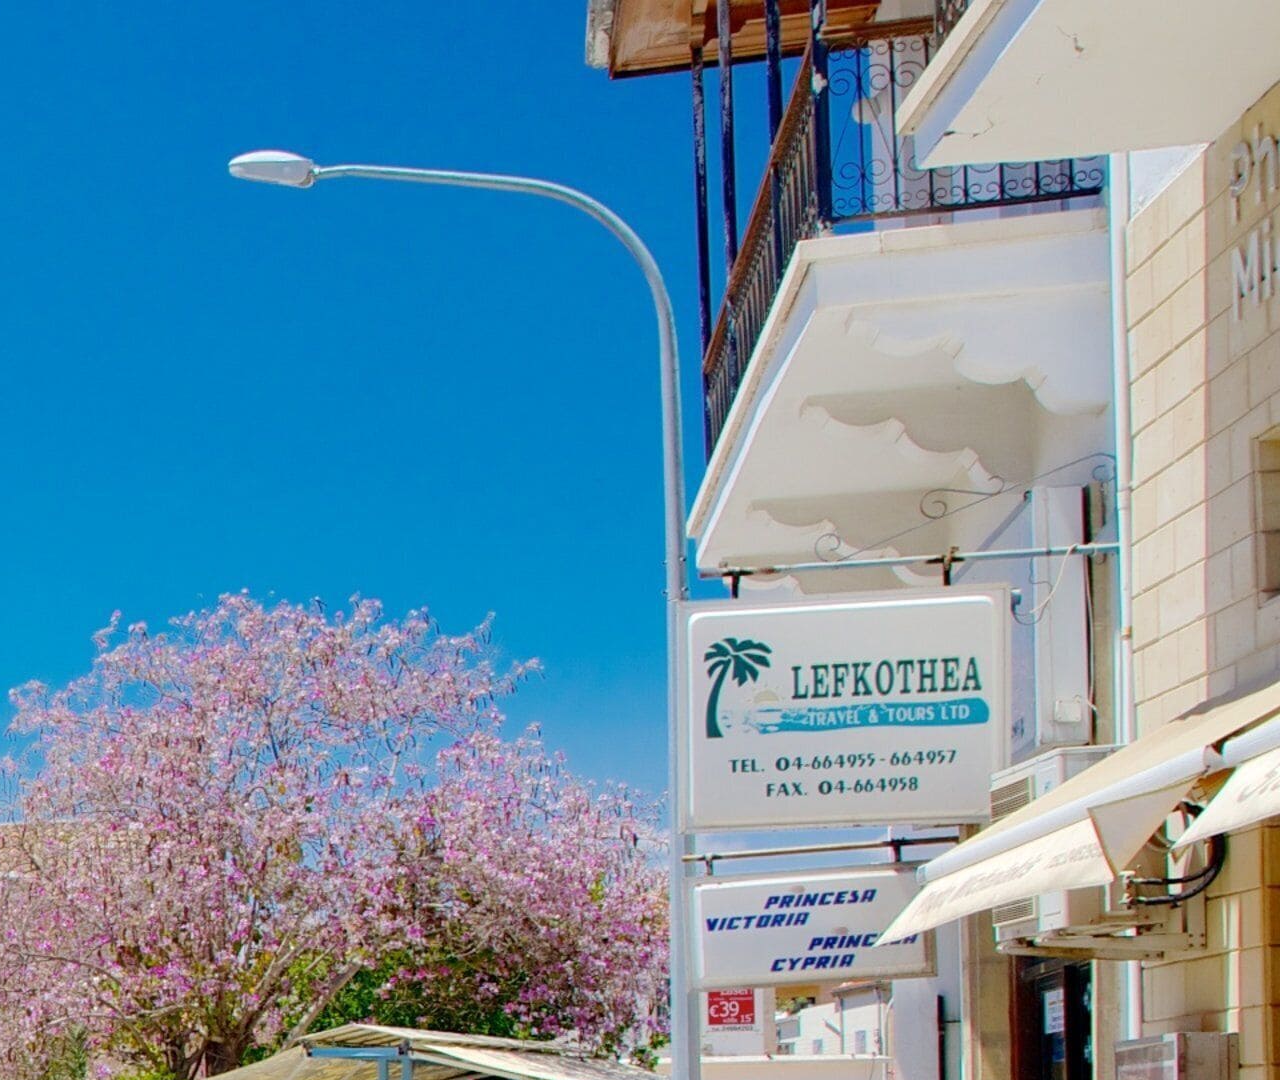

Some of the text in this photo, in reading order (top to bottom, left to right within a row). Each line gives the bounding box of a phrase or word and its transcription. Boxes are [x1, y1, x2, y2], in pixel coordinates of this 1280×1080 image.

[791, 657, 982, 700] LEFKOTHEA
[807, 704, 970, 726] TRAVEL & TOURS LTD
[728, 758, 765, 773] TEL.
[889, 749, 958, 766] 664957
[766, 776, 920, 797] FAX. 04-664958
[764, 888, 878, 910] PRINCESA
[705, 911, 810, 932] VICTORIA
[808, 932, 919, 951] PRINCA
[770, 953, 855, 972] CYPRIA
